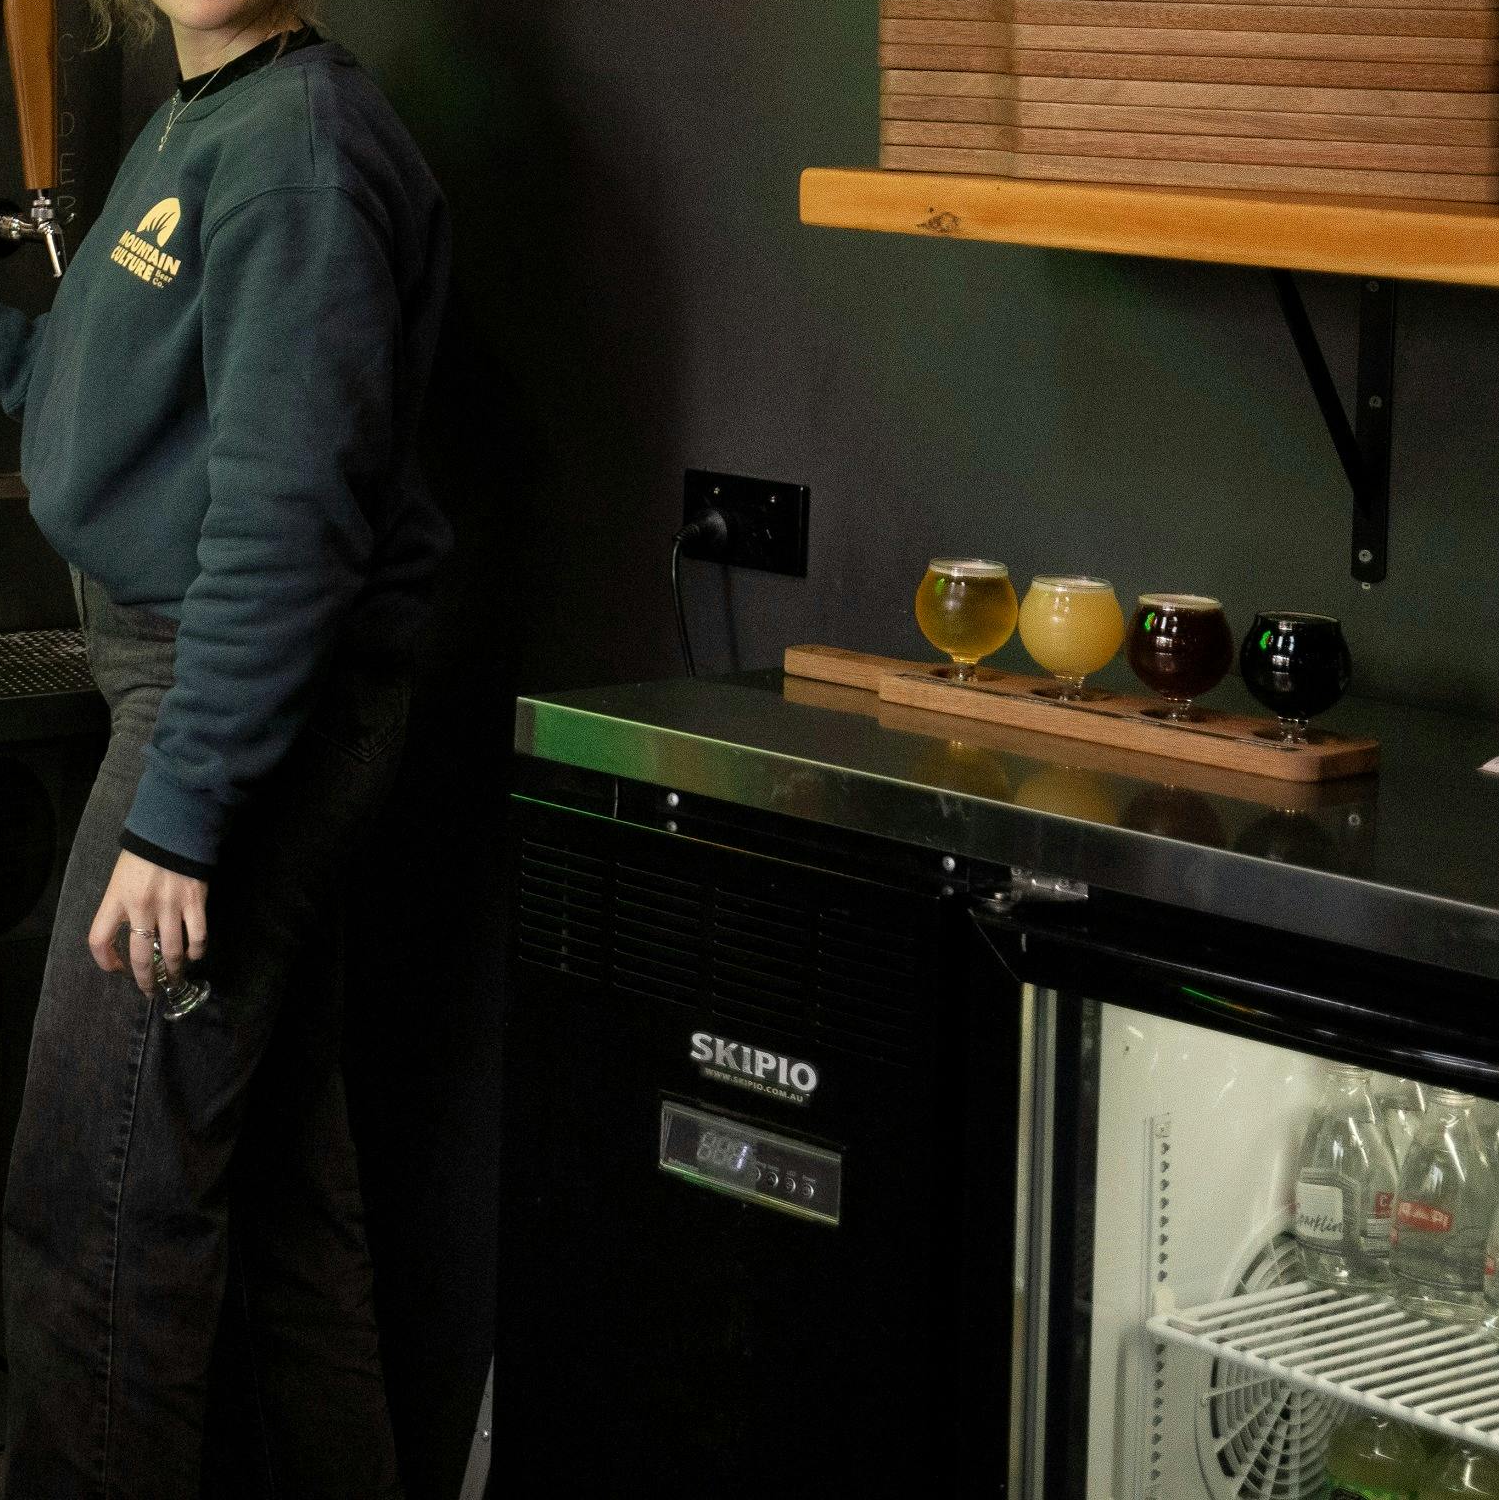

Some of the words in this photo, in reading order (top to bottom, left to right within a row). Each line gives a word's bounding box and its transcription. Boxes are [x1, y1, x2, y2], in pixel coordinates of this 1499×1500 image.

[110, 245, 155, 282] CULTURE
[118, 229, 182, 276] MOUNTAIN
[155, 269, 173, 284] Beer
[689, 1031, 818, 1093] SKIPIO
